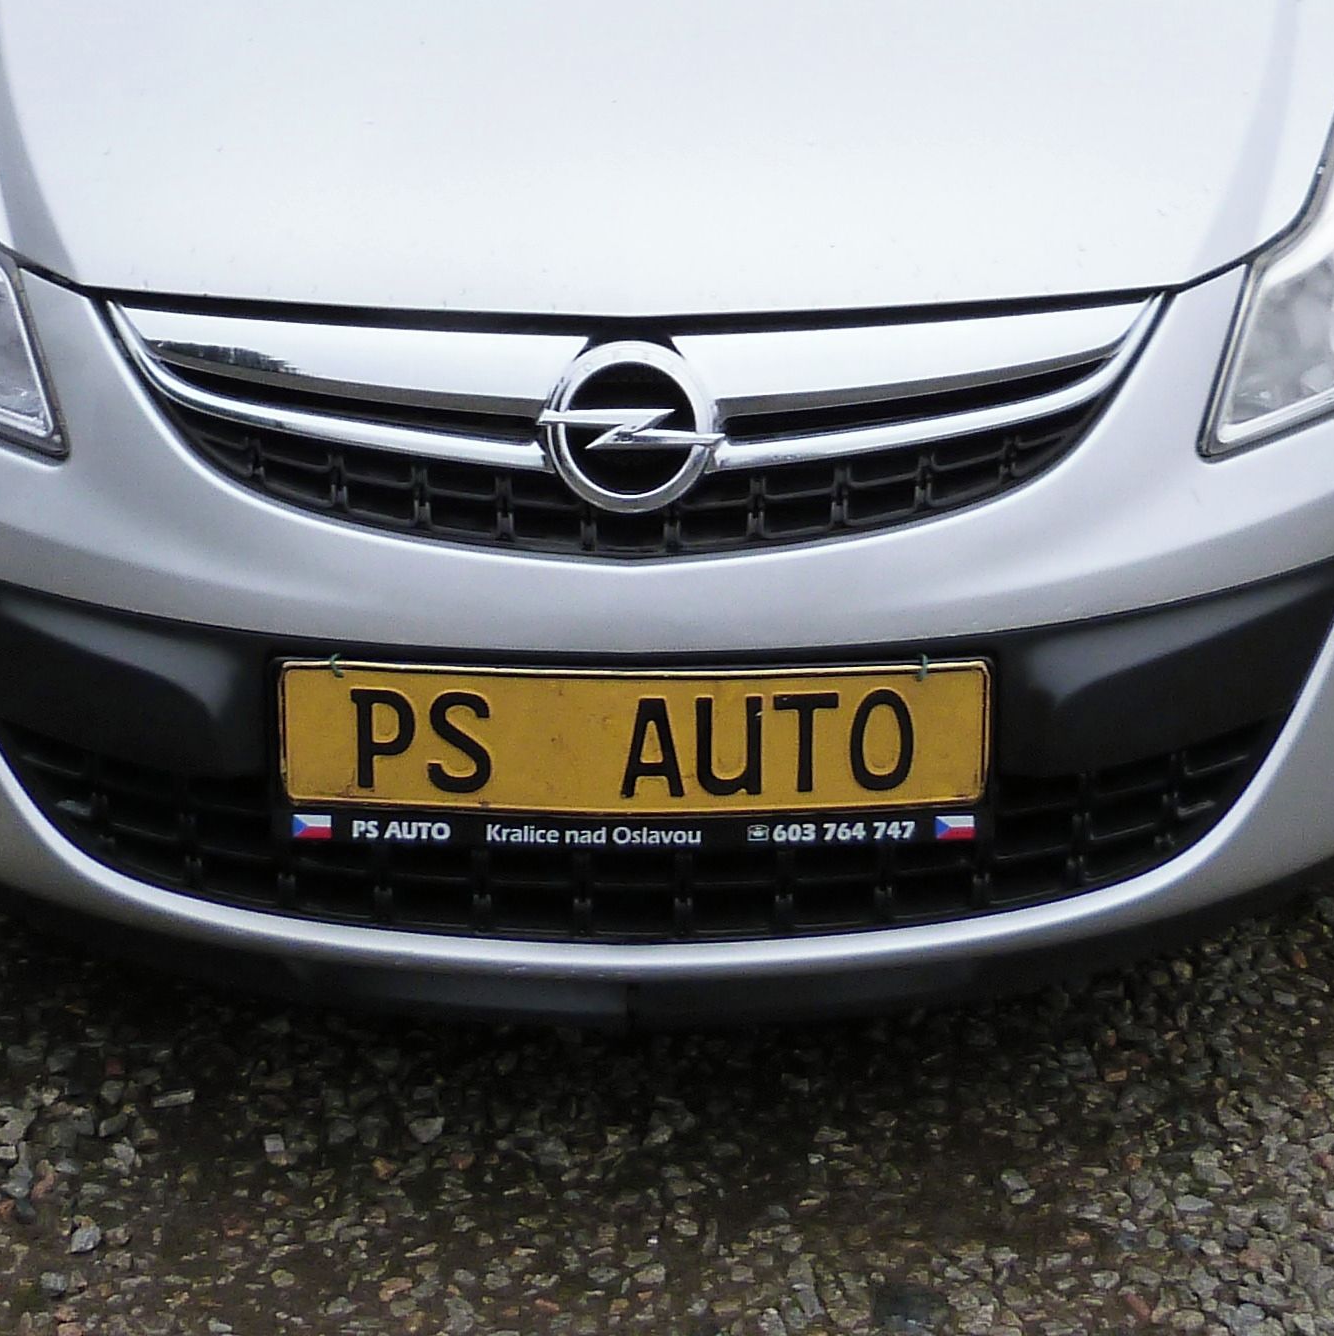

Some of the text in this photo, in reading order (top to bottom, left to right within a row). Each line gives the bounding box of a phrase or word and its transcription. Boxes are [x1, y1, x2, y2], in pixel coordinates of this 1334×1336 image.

[350, 688, 914, 798] PS AUTO
[351, 820, 452, 841] PS AUTO
[485, 824, 702, 845] Kralice nad Oslavou
[772, 821, 916, 843] 603 764 747
